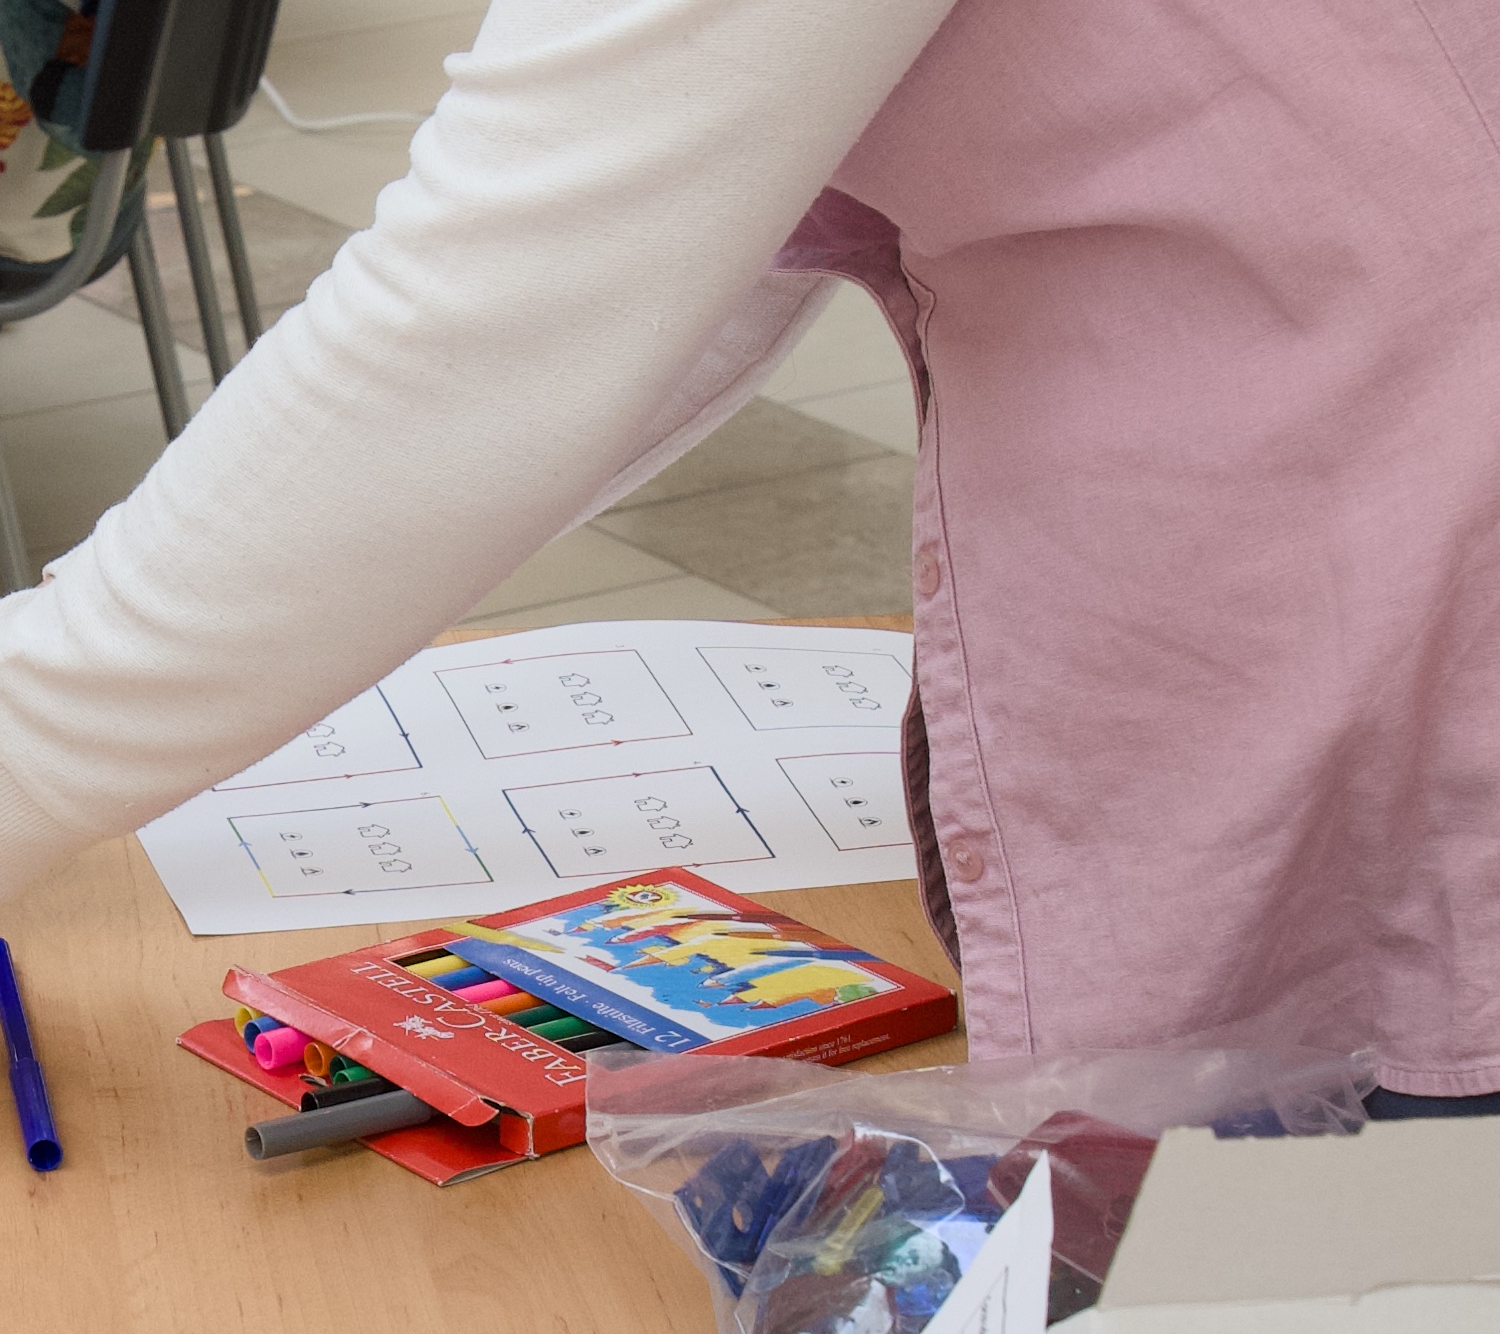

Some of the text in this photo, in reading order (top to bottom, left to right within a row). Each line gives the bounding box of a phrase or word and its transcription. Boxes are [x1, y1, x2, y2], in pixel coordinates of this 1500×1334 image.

[502, 957, 539, 978] pens
[534, 969, 557, 987] tip
[554, 984, 588, 1003] Felt
[350, 961, 587, 1087] FABER-CASTELL
[654, 1030, 692, 1049] 12
